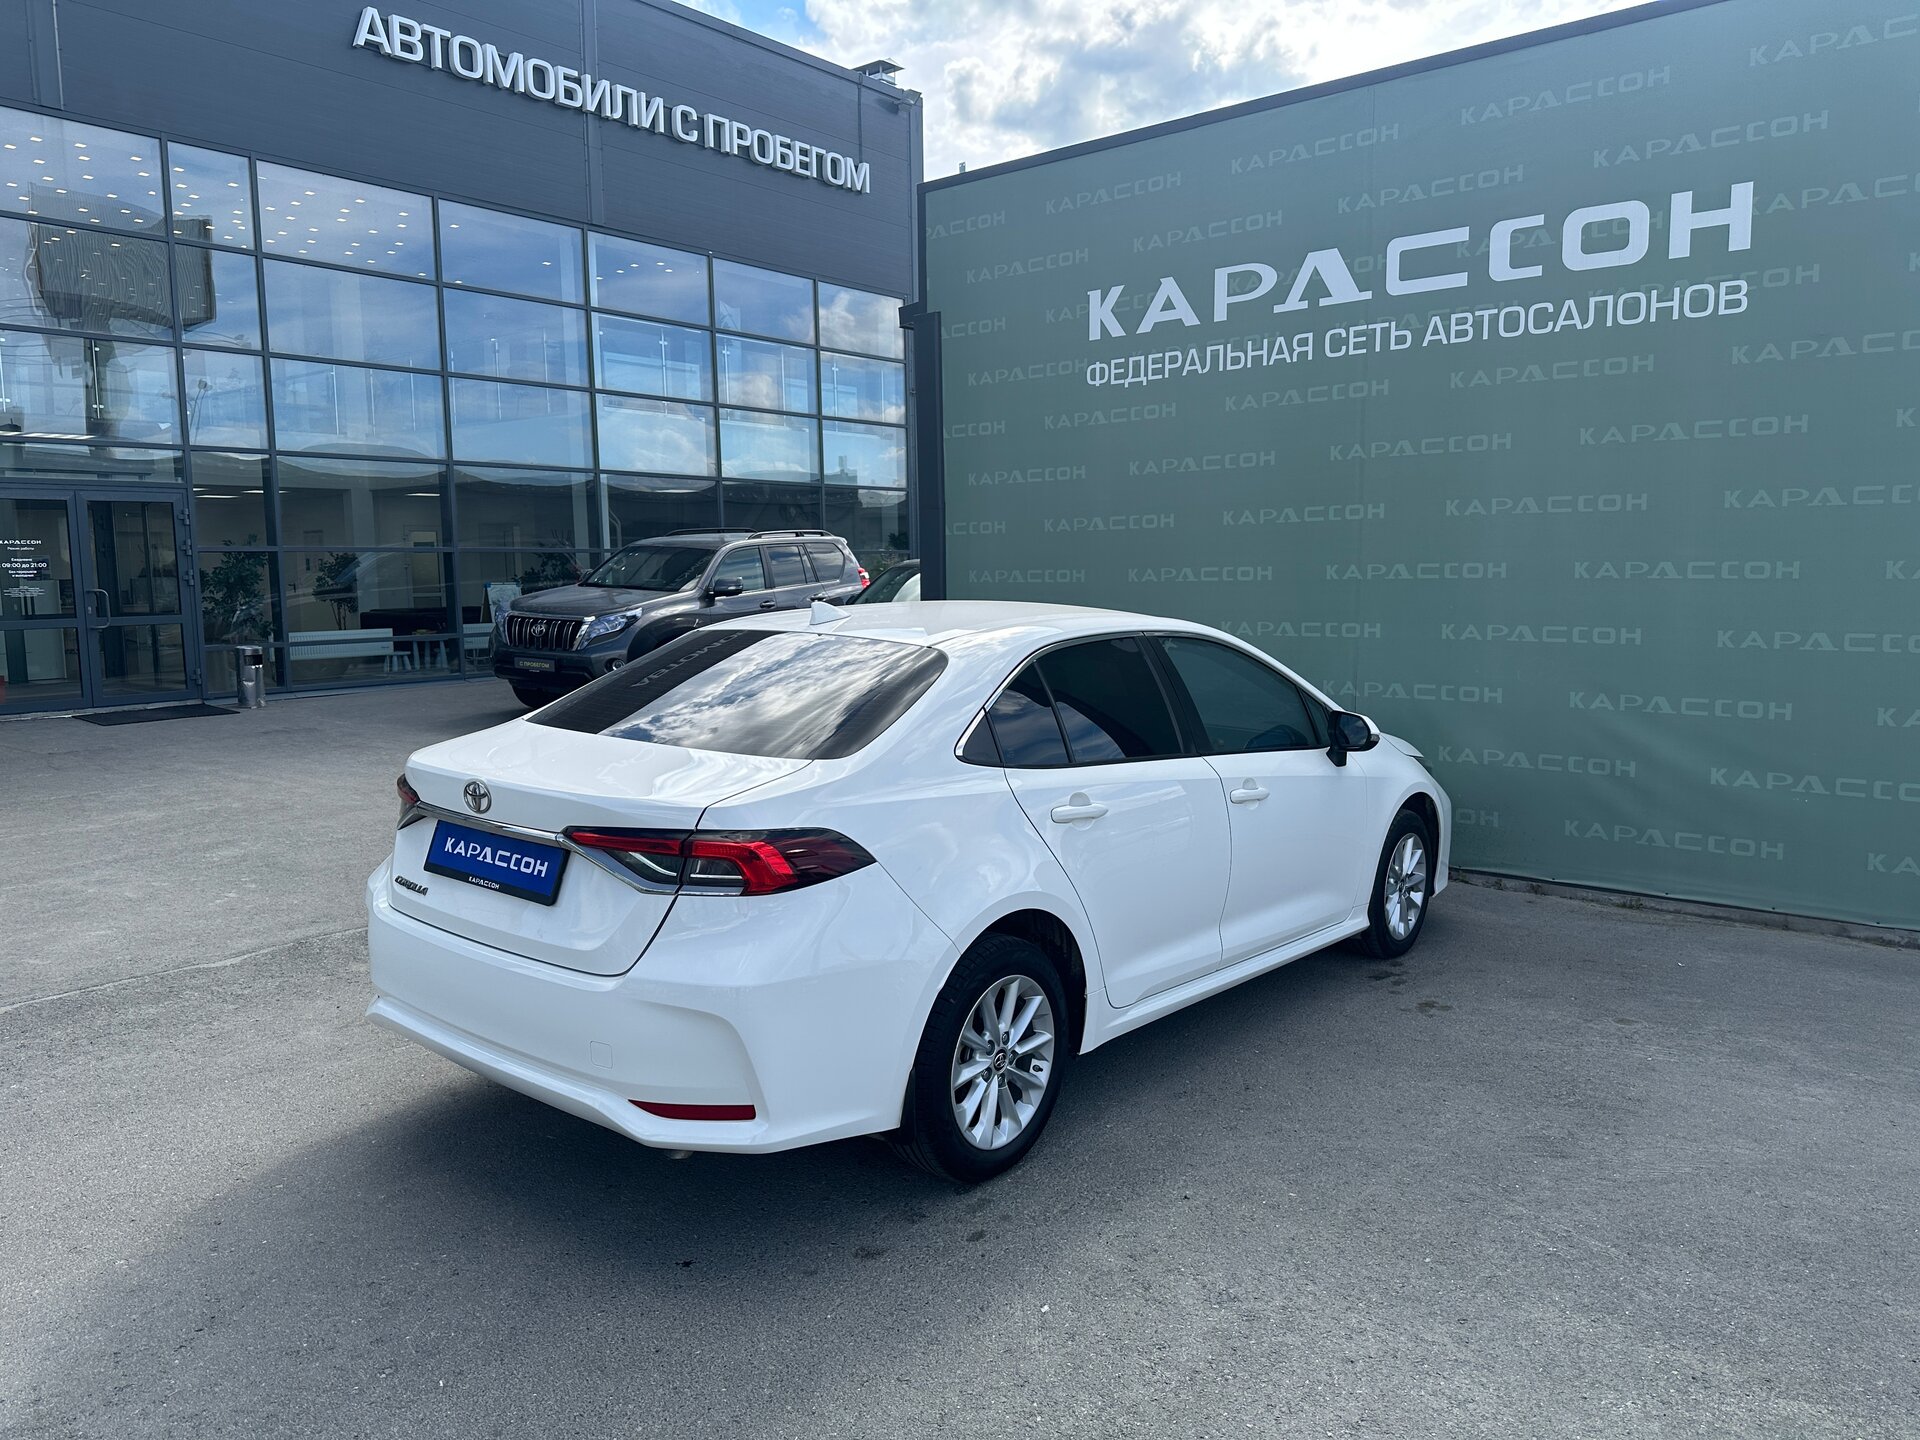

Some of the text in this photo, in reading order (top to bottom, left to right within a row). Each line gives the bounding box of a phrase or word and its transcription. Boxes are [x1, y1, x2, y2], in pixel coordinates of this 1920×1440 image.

[352, 6, 870, 194] АВТОМОБИЛИ С ПРОБЕГОМ
[1086, 332, 1313, 388] ФЕДЕРАЛЬНАЯ
[1324, 321, 1412, 358] СЕТЬ
[1421, 279, 1749, 347] АВТОСАЛОНОВ
